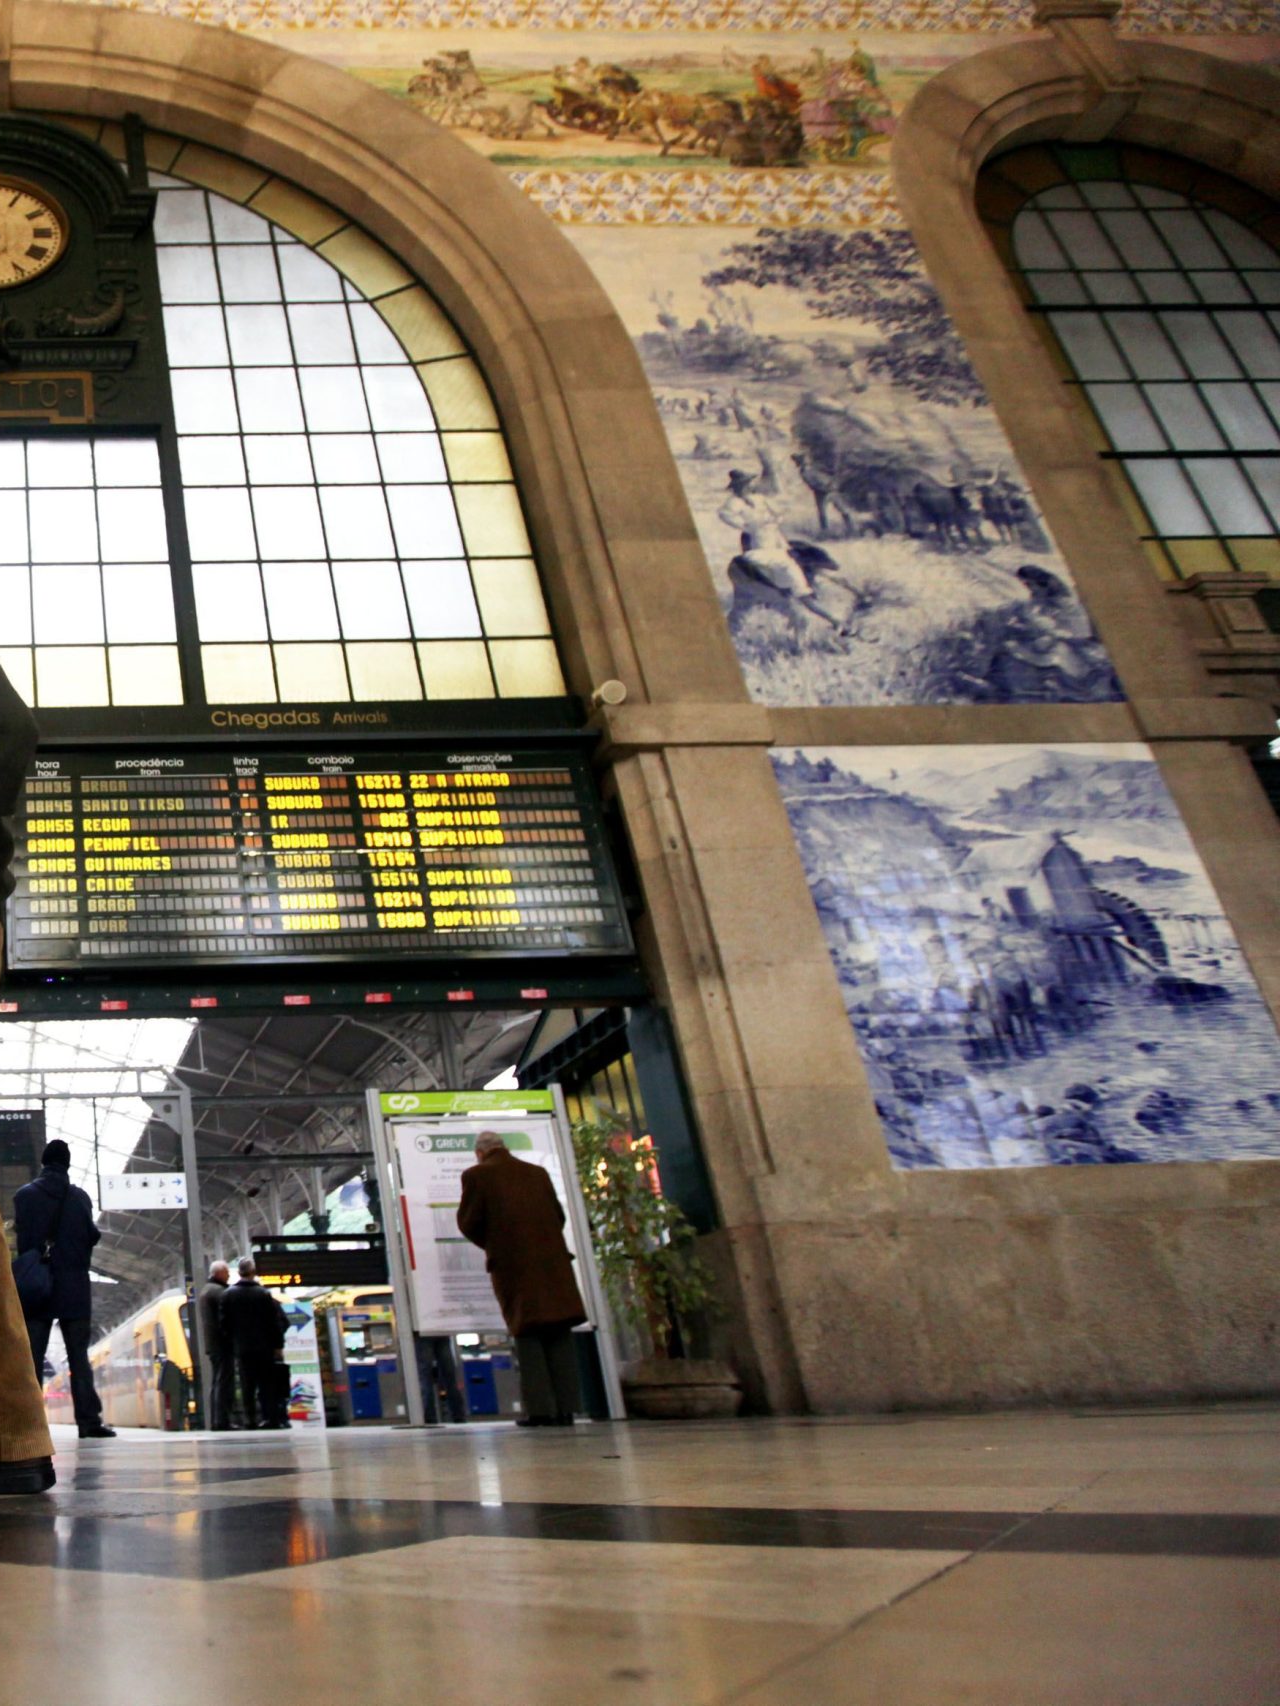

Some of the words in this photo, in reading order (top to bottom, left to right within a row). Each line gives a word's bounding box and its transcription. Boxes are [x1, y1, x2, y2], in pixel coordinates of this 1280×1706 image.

[211, 710, 320, 729] Chegadas
[333, 710, 388, 724] Arrivals
[36, 760, 60, 769] hora
[115, 758, 184, 769] procedência
[233, 757, 259, 766] linha
[308, 755, 354, 764] comboio
[447, 753, 512, 764] observações
[235, 766, 258, 774] track
[80, 780, 128, 793] BRAGA
[264, 776, 320, 790] SUBURB
[355, 774, 402, 789] 15212
[410, 774, 429, 789] 22
[454, 772, 510, 786] ATRASO
[26, 800, 72, 814] 08H45
[82, 798, 129, 812] SANTO
[138, 798, 184, 812] TIRSO
[266, 796, 323, 810] SUBURB
[413, 792, 496, 807] SUPRIMIDO
[26, 819, 74, 834] 08H55
[82, 818, 130, 832] REGUA
[271, 815, 289, 829] IR
[416, 810, 500, 825] SUPRIMIDO
[83, 836, 160, 852] PENAFIEL
[272, 834, 328, 848] SUBURB
[419, 829, 504, 846] SUPRIMIDO
[28, 858, 76, 873] 09H05
[84, 857, 171, 872] GUIMARAES
[274, 854, 331, 868] SUBURB
[29, 878, 78, 893] 09H10
[86, 878, 134, 892] CAIDE
[277, 874, 334, 888] SUBURB
[372, 872, 420, 887] 15514
[426, 869, 512, 886] SUPRIMIDO
[88, 898, 136, 912] BRAGA
[279, 893, 338, 909] SUBURB
[429, 890, 516, 906] SUPRIMIDO
[89, 919, 128, 934] OVAR
[281, 914, 340, 930] SUBURB
[432, 909, 520, 926] SUPRIMIDO
[436, 1138, 468, 1148] GREVE
